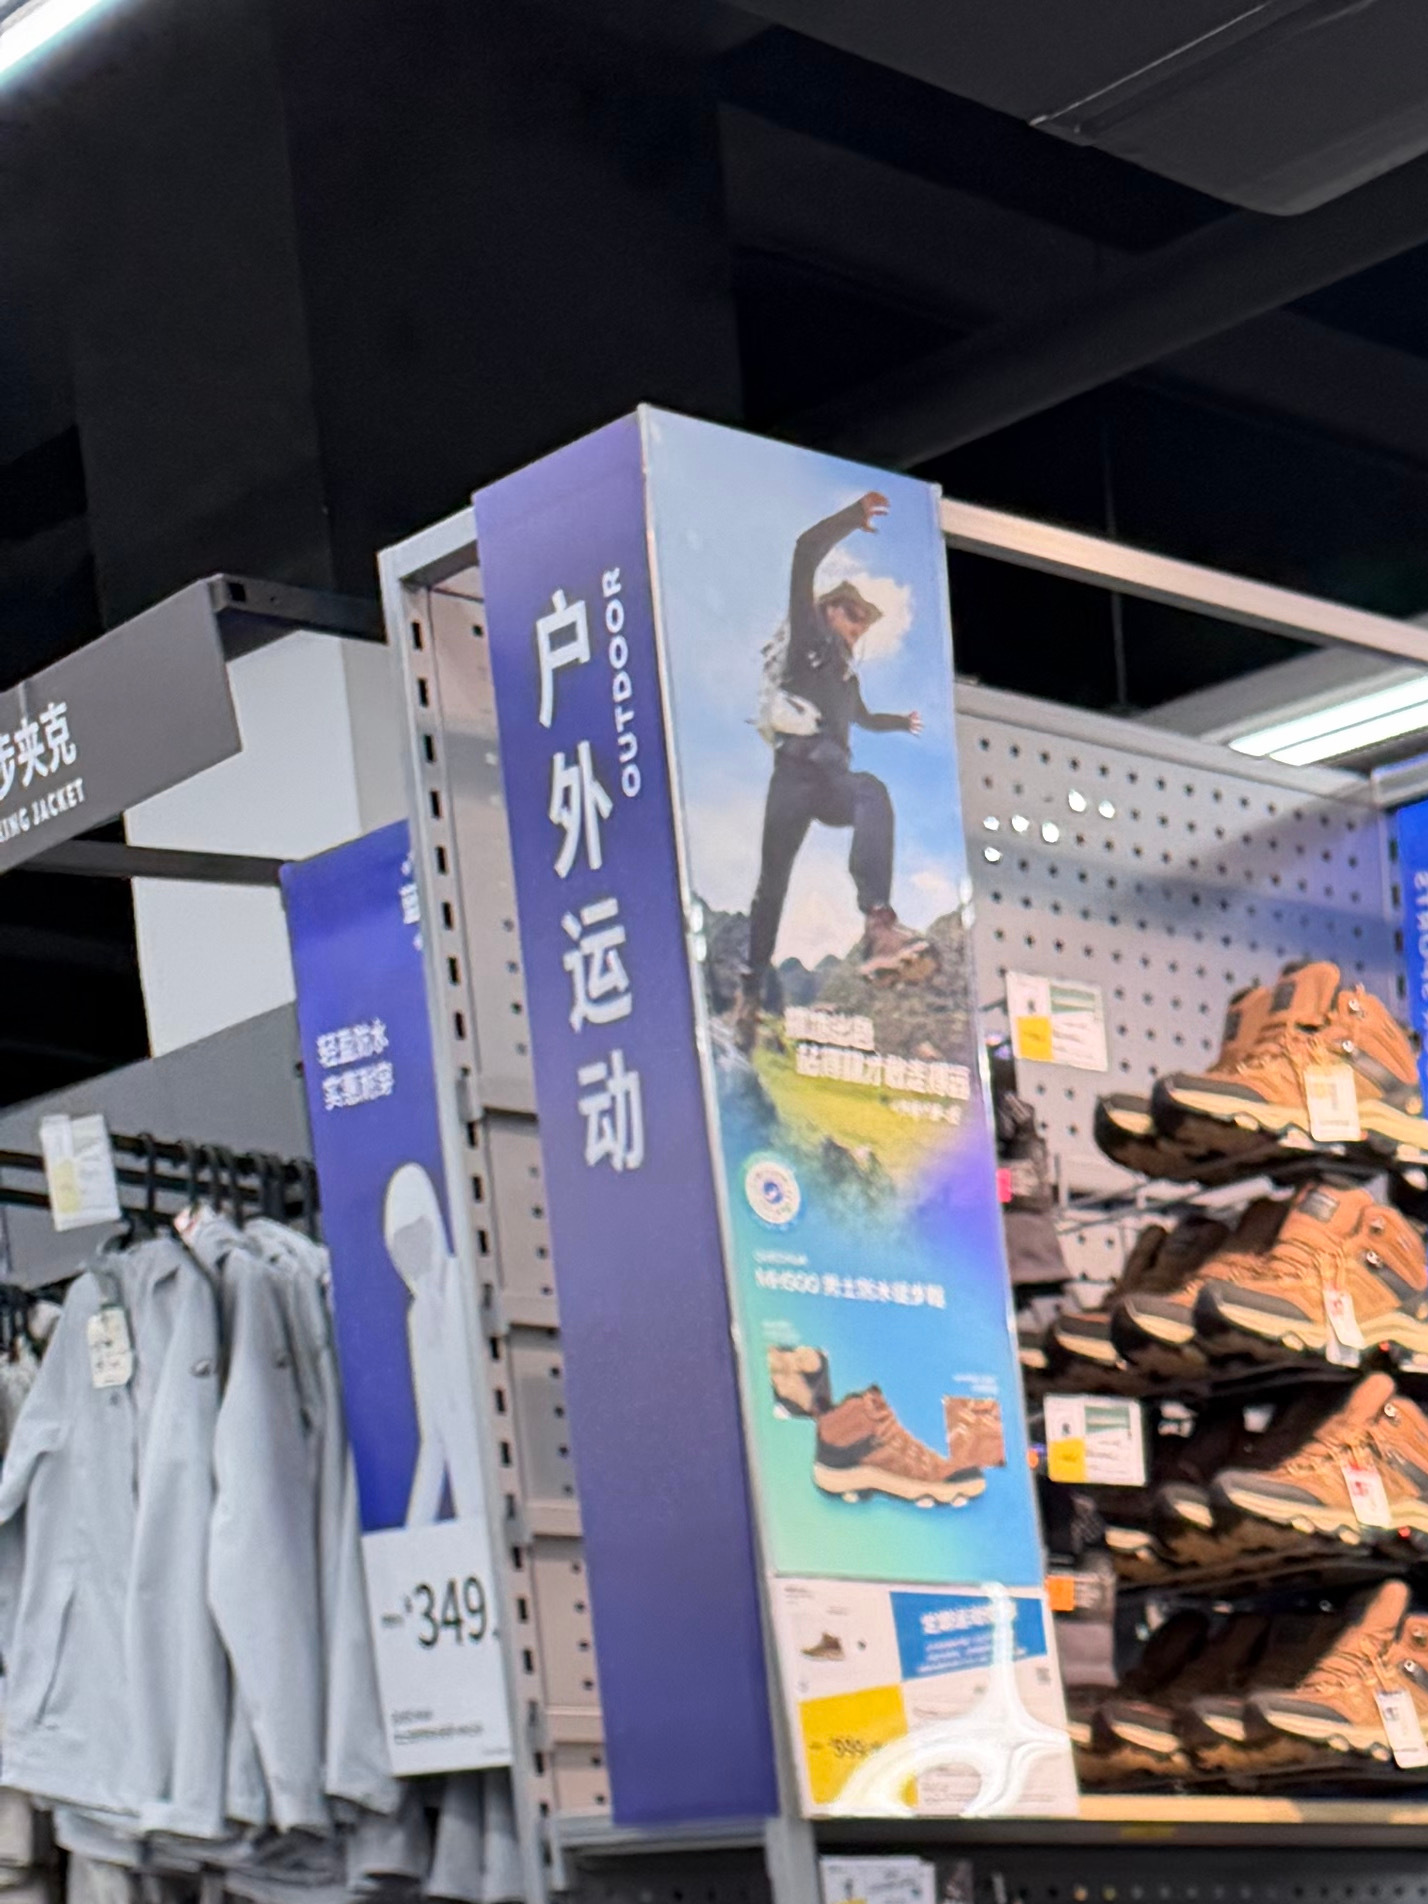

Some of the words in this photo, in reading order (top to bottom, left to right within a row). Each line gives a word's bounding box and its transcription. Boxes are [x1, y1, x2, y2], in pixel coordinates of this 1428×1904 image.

[602, 567, 641, 799] OUTDOOR
[0, 807, 31, 843] ING
[31, 777, 85, 827] JACKET
[535, 589, 645, 1173] 户外运动
